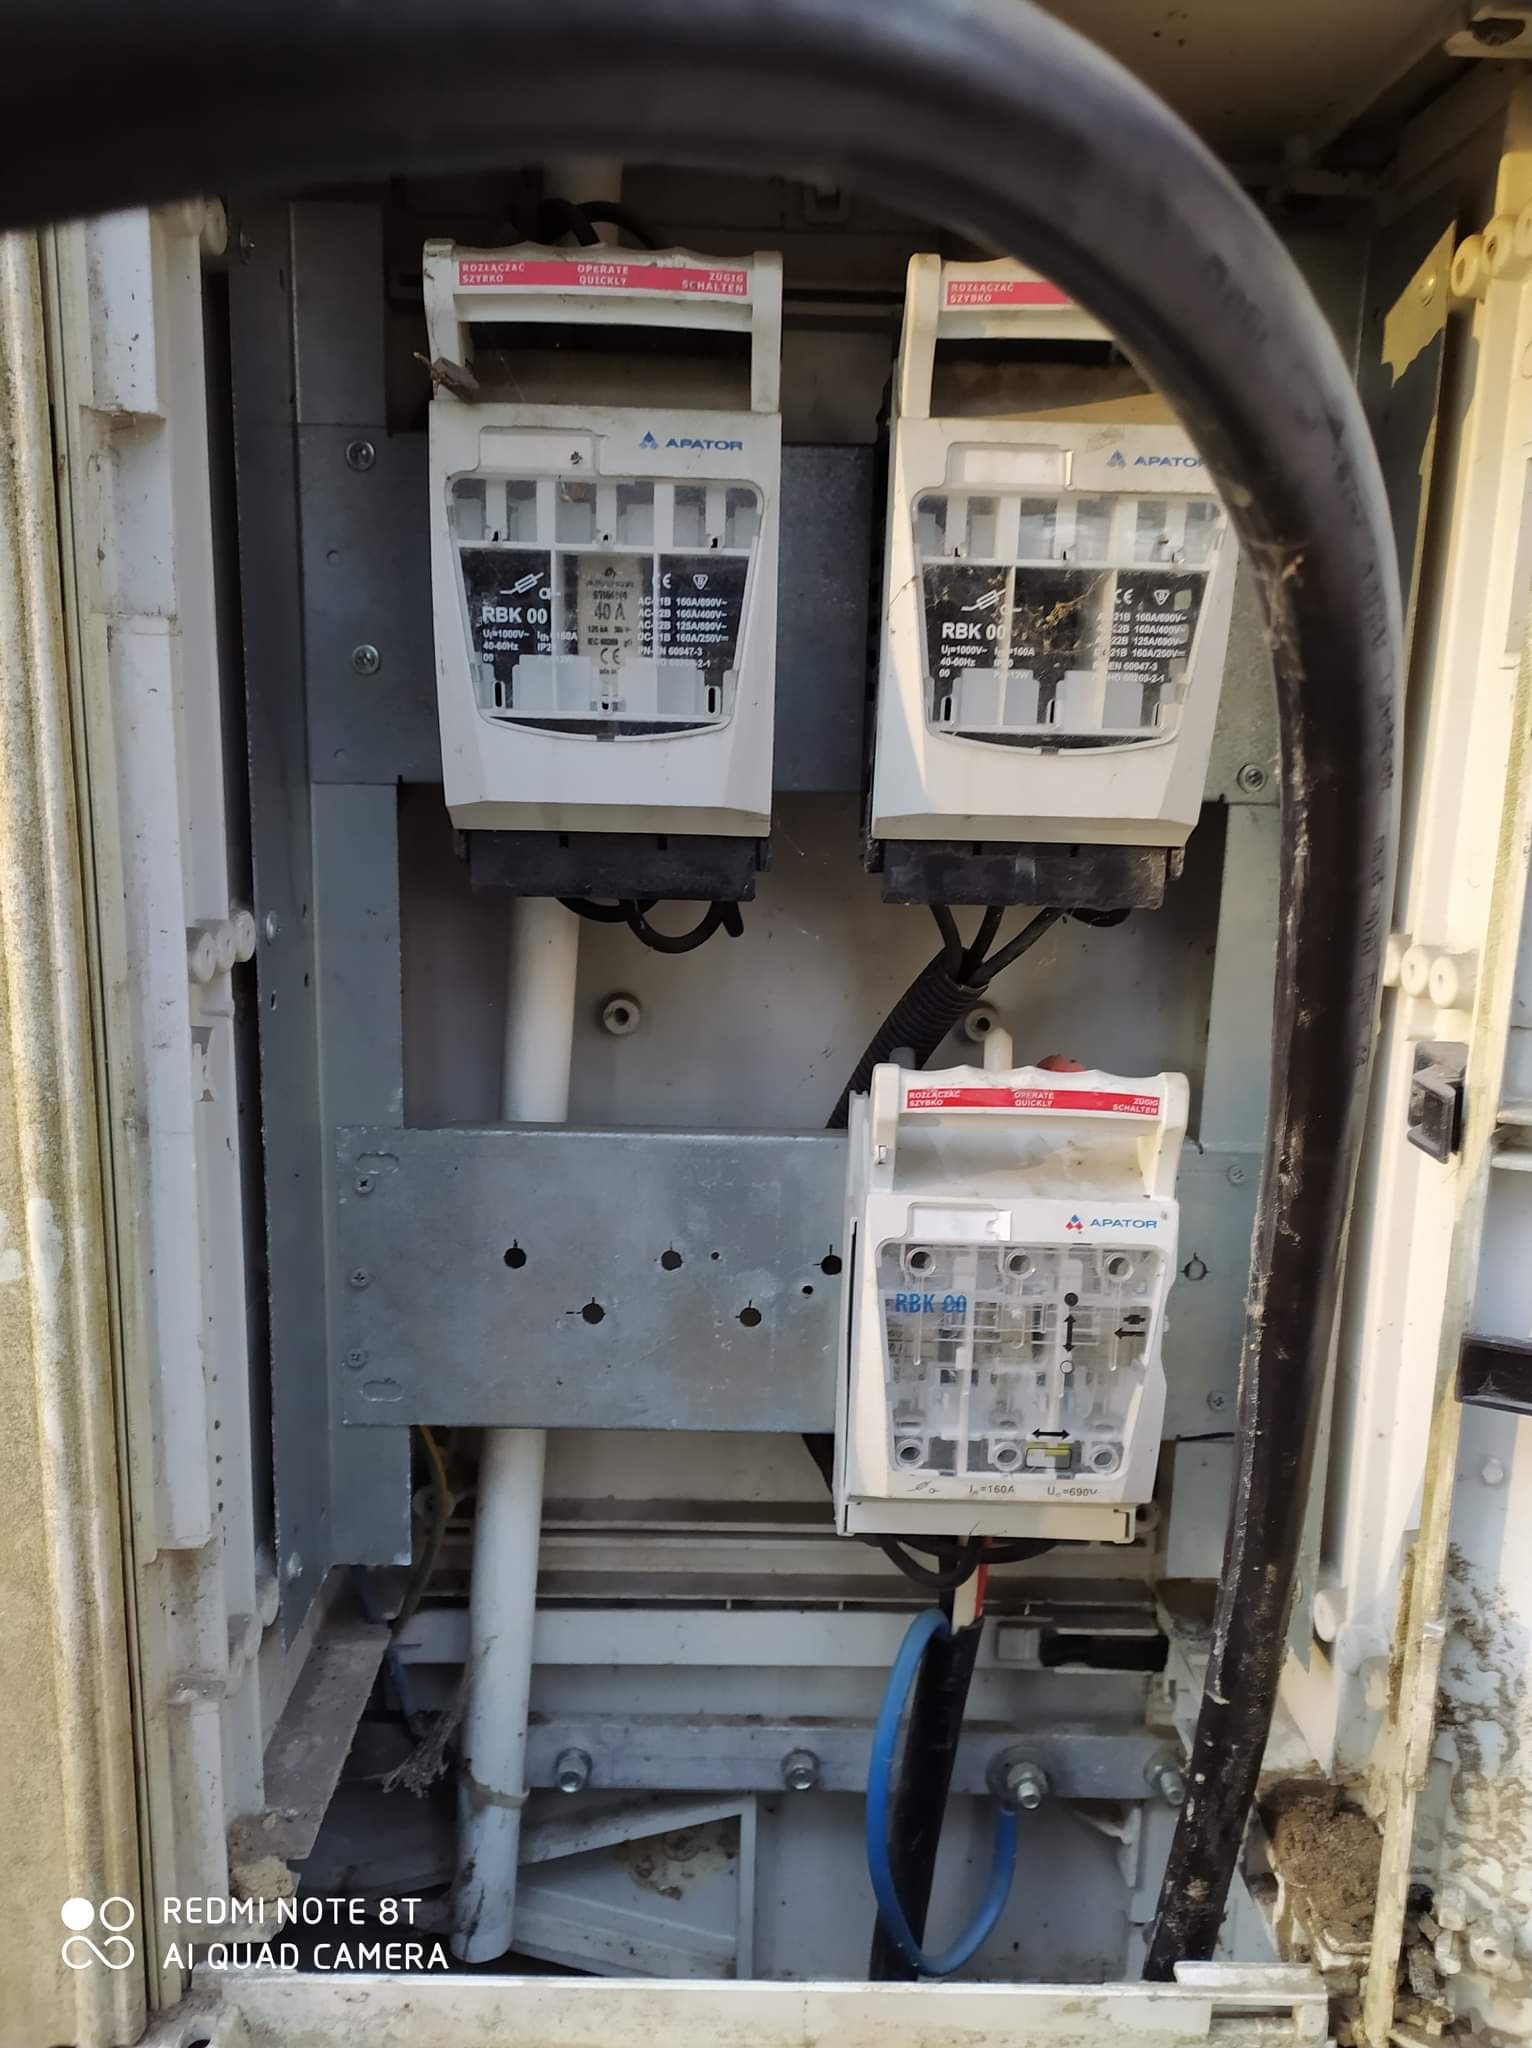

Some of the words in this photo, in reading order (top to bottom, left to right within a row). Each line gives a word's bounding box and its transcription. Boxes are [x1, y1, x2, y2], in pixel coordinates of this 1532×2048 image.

[577, 264, 629, 275] OPERATE
[462, 274, 504, 283] SZYBKO
[579, 275, 627, 286] QUICKLY
[709, 271, 744, 283] ZÜGIG
[682, 279, 744, 293] SCHALTEN
[950, 294, 992, 303] SZYBKO
[665, 438, 744, 451] APATOR
[1133, 456, 1202, 468] APATO
[482, 606, 523, 624] RBK
[526, 607, 547, 625] 00
[593, 602, 611, 621] 40
[614, 602, 626, 621] A
[941, 622, 982, 640] RBK
[986, 623, 1006, 640] 00
[1014, 1091, 1054, 1099] OPERATE
[909, 1099, 943, 1107] SZYBKO
[1015, 1099, 1052, 1107] QUICKLY
[1112, 1104, 1157, 1114] SCHALTEN
[1090, 1218, 1157, 1228] APATOR
[896, 1293, 935, 1312] RBK
